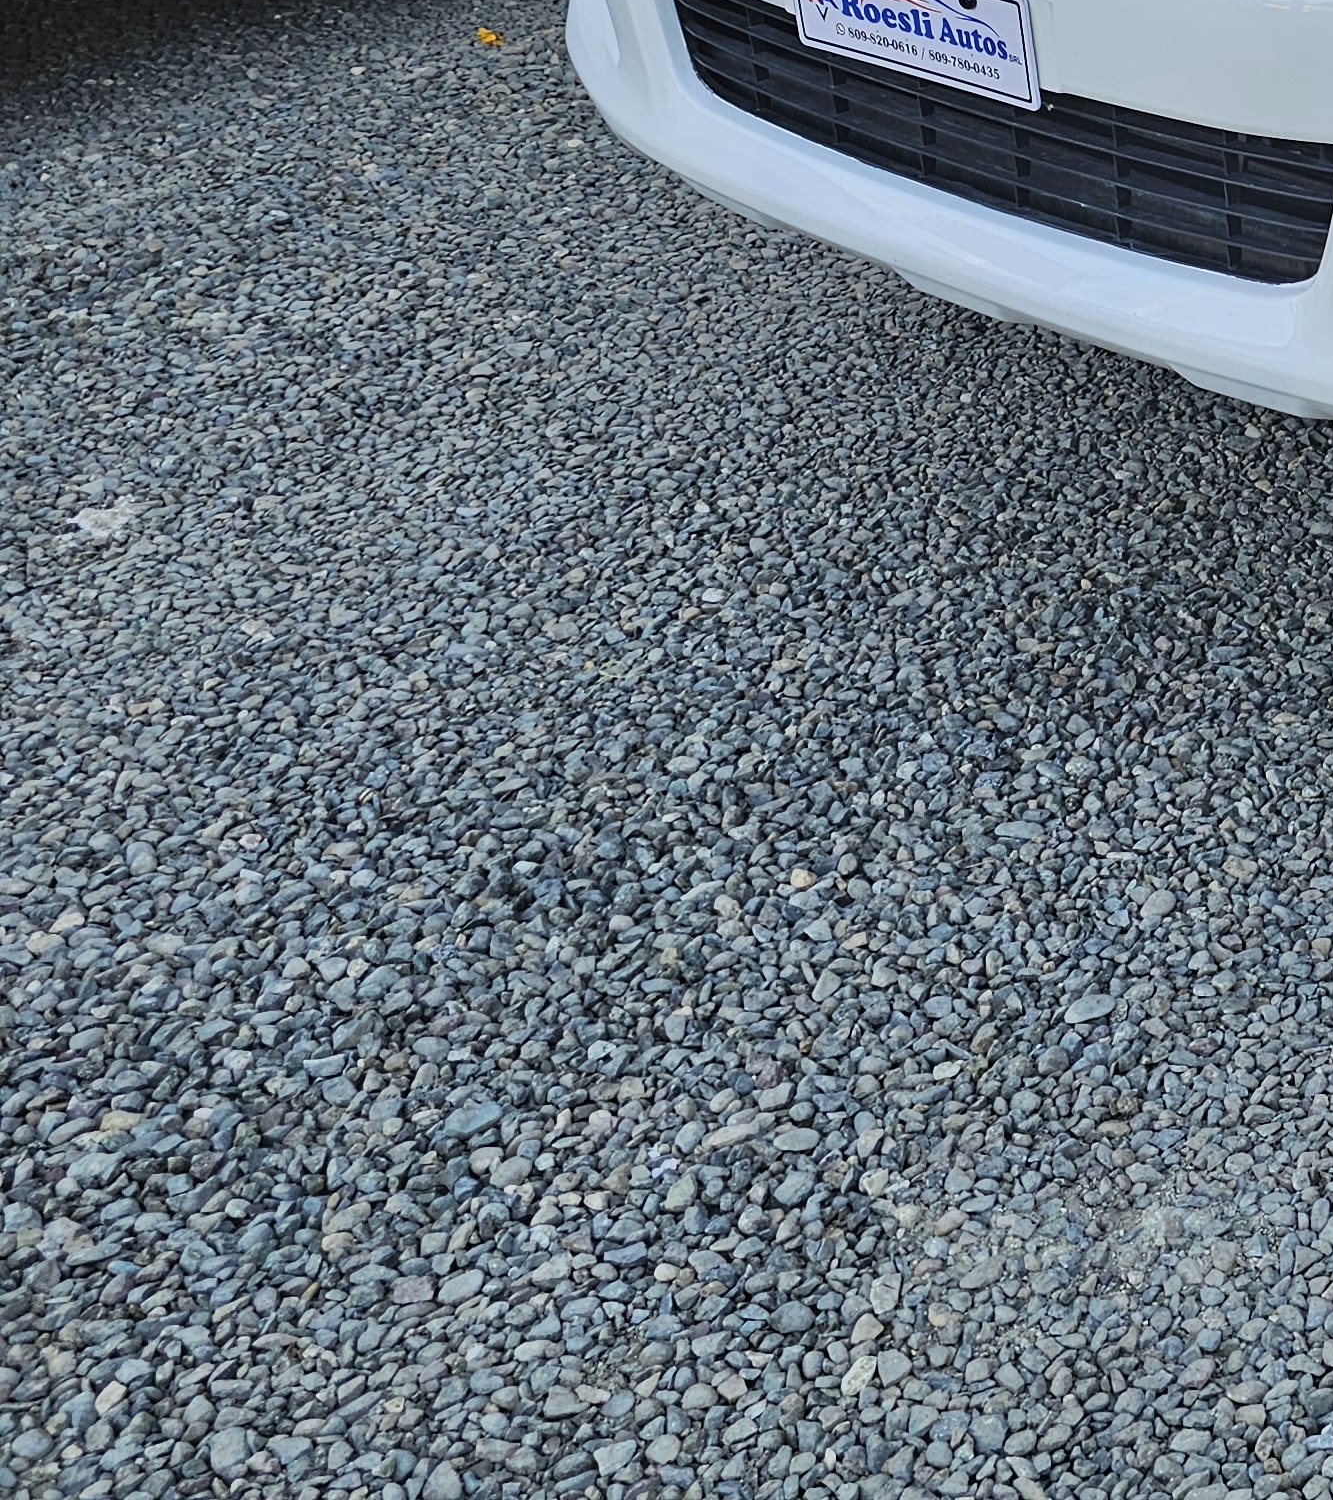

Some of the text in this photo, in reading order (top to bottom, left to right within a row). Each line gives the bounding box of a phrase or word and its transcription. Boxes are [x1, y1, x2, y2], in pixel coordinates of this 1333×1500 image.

[847, 26, 919, 57] 809-820-0616
[928, 49, 1001, 80] 809-780-0435
[939, 17, 1008, 60] Autos
[1008, 54, 1023, 66] SRL
